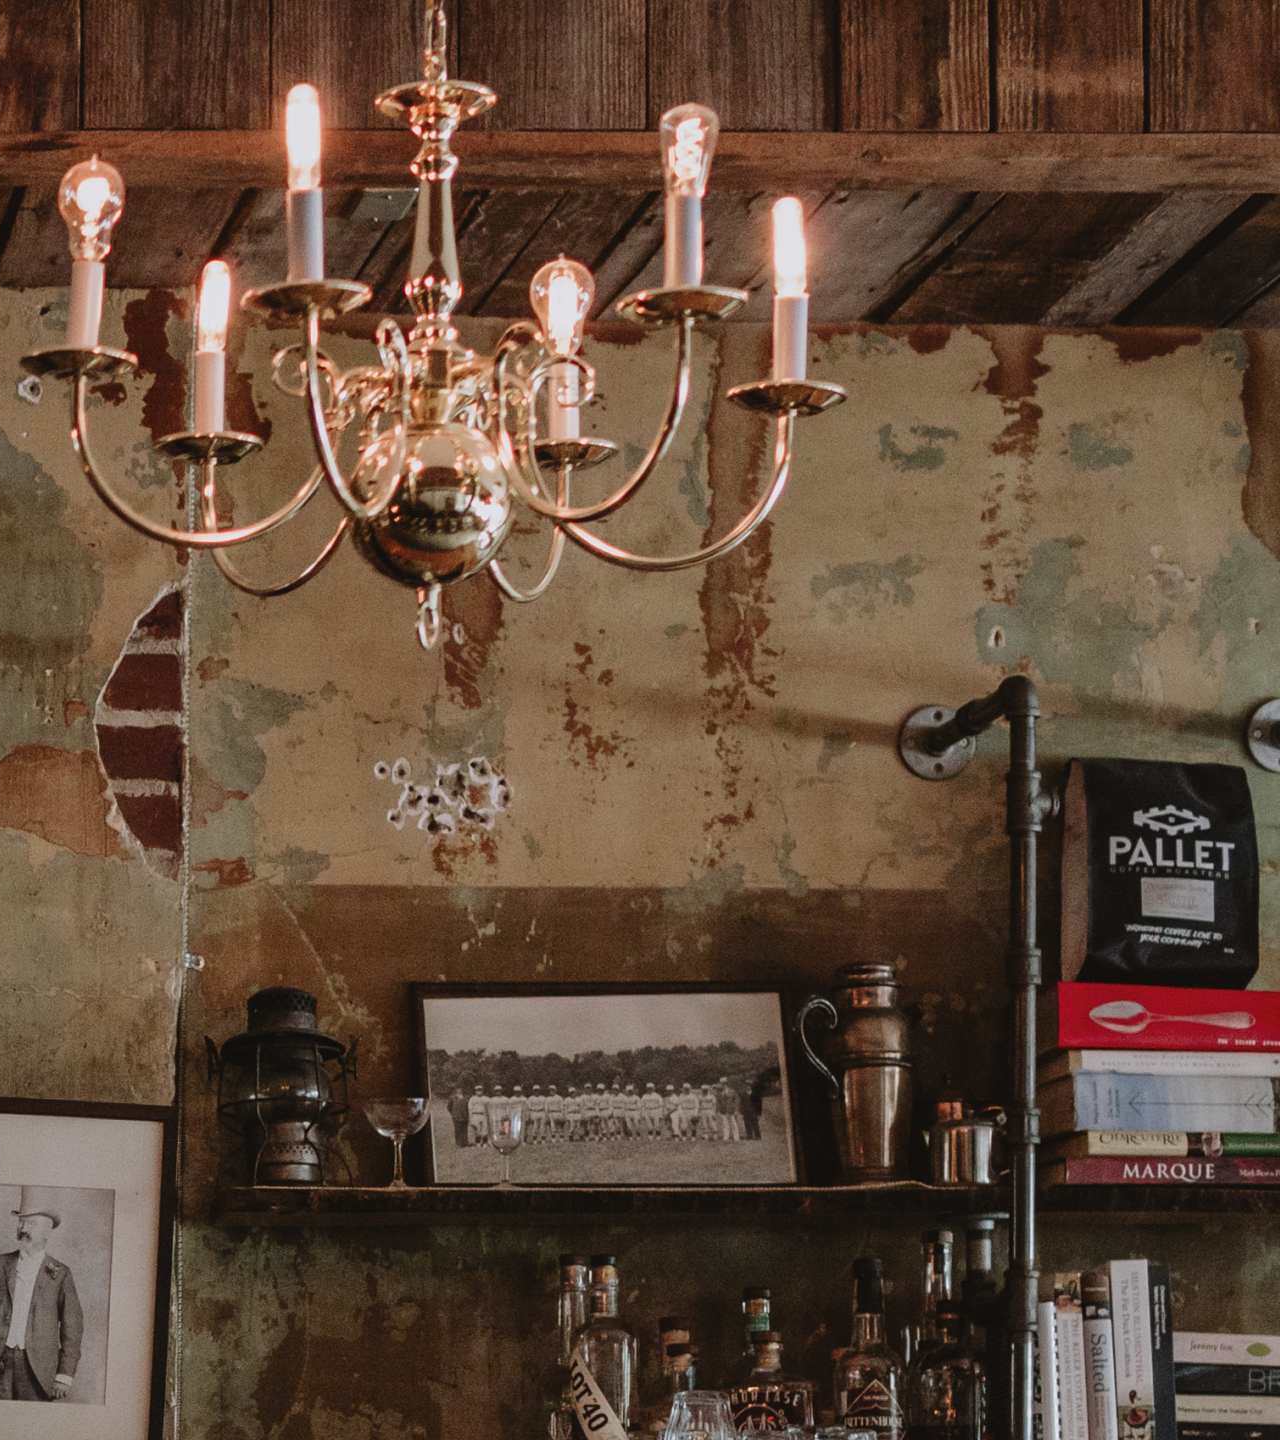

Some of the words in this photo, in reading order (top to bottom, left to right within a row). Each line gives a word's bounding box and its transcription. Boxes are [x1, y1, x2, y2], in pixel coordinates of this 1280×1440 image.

[1108, 835, 1235, 872] PALLET
[1109, 866, 1158, 875] COFFEE
[1122, 1163, 1216, 1183] MARQUE
[1089, 1333, 1110, 1394] Salted
[583, 1398, 609, 1433] 40
